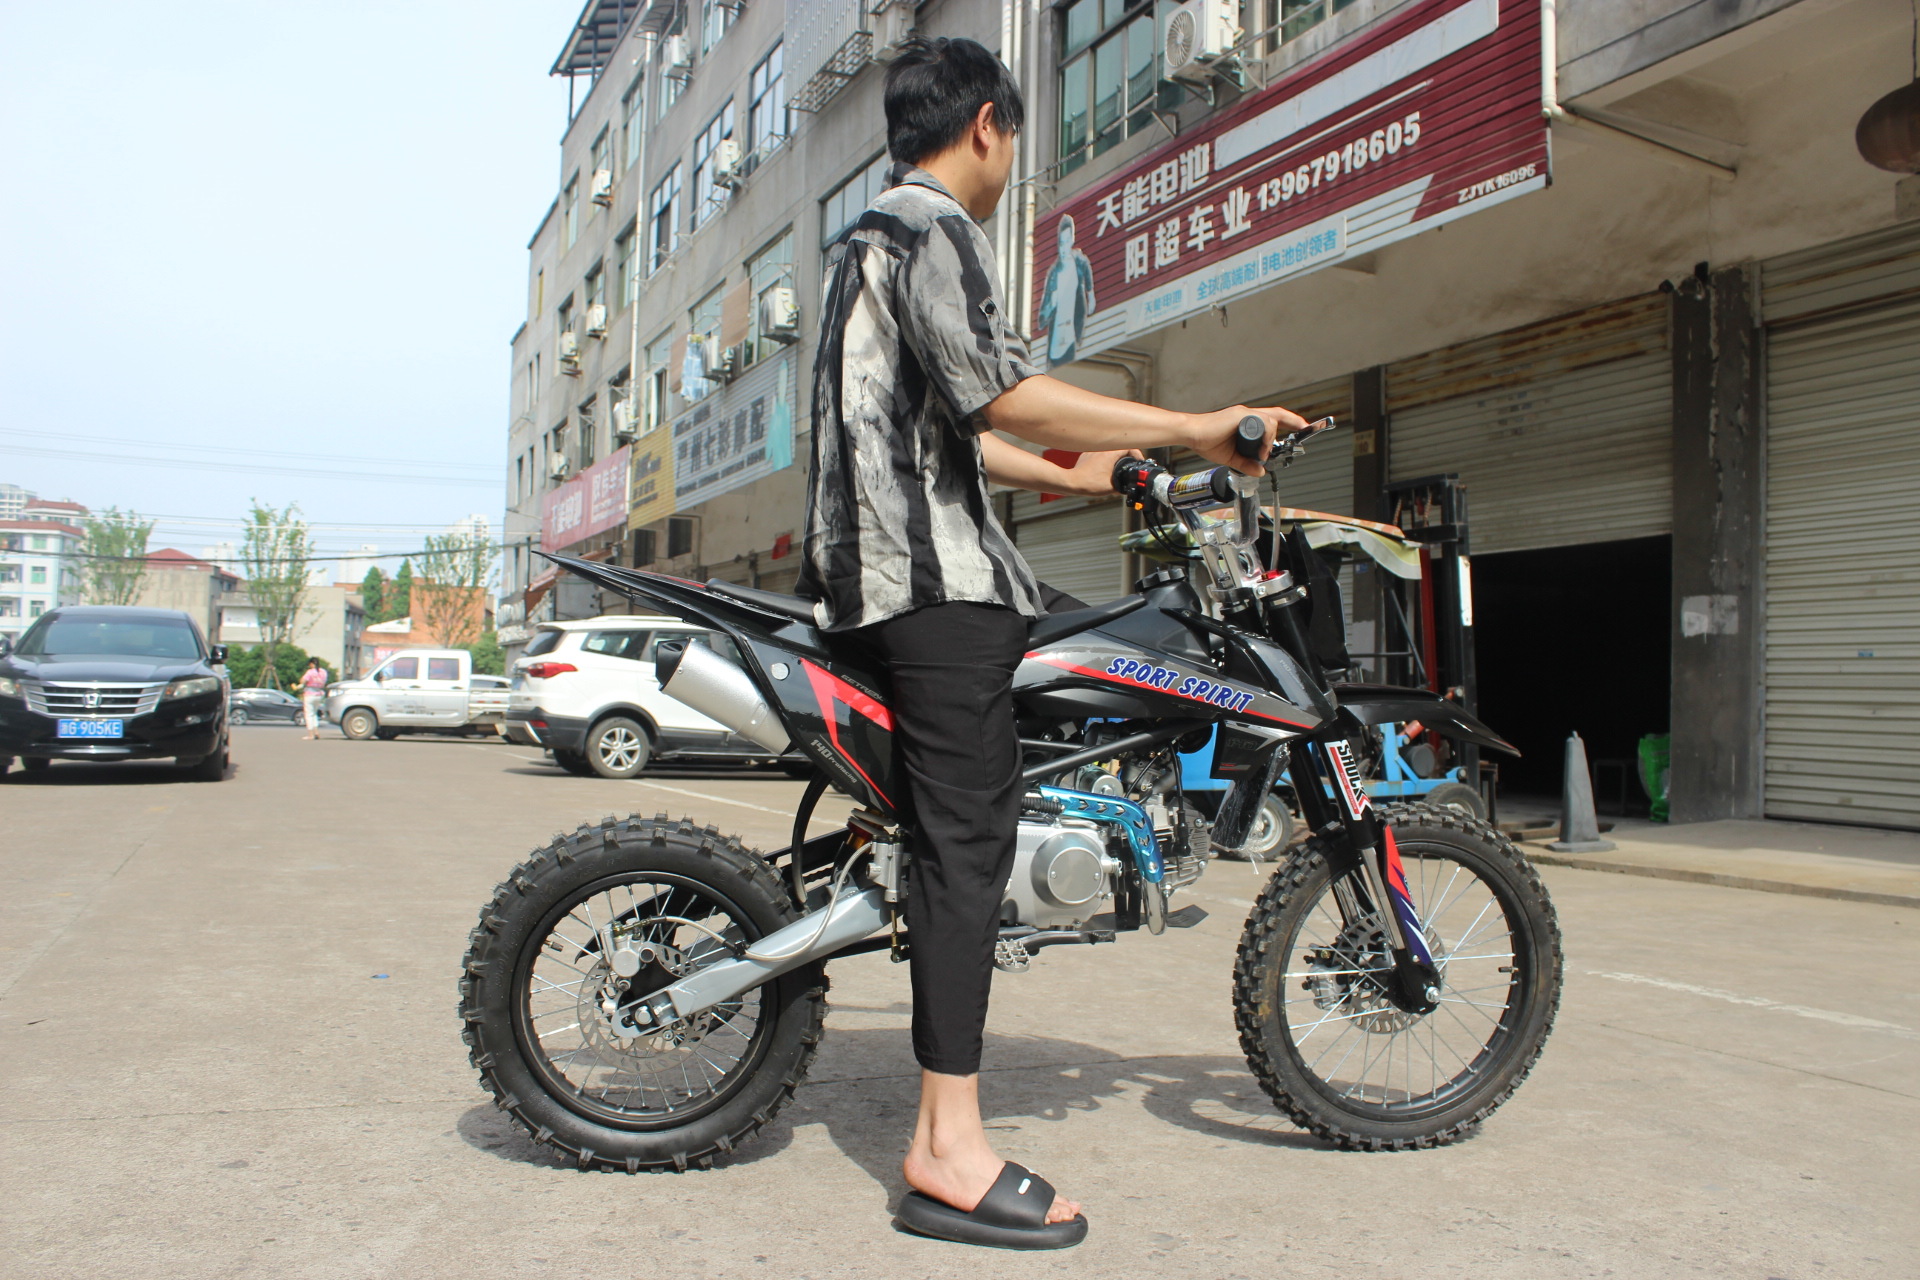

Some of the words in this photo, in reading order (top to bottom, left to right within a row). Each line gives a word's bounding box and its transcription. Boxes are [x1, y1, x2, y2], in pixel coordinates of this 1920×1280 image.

[1096, 142, 1210, 238] 天能电池
[1125, 186, 1251, 284] 阳超车业
[1257, 111, 1421, 212] 13967918605
[1106, 656, 1179, 691] SPORT
[1177, 677, 1255, 713] SPIRIT
[810, 739, 833, 759] 140
